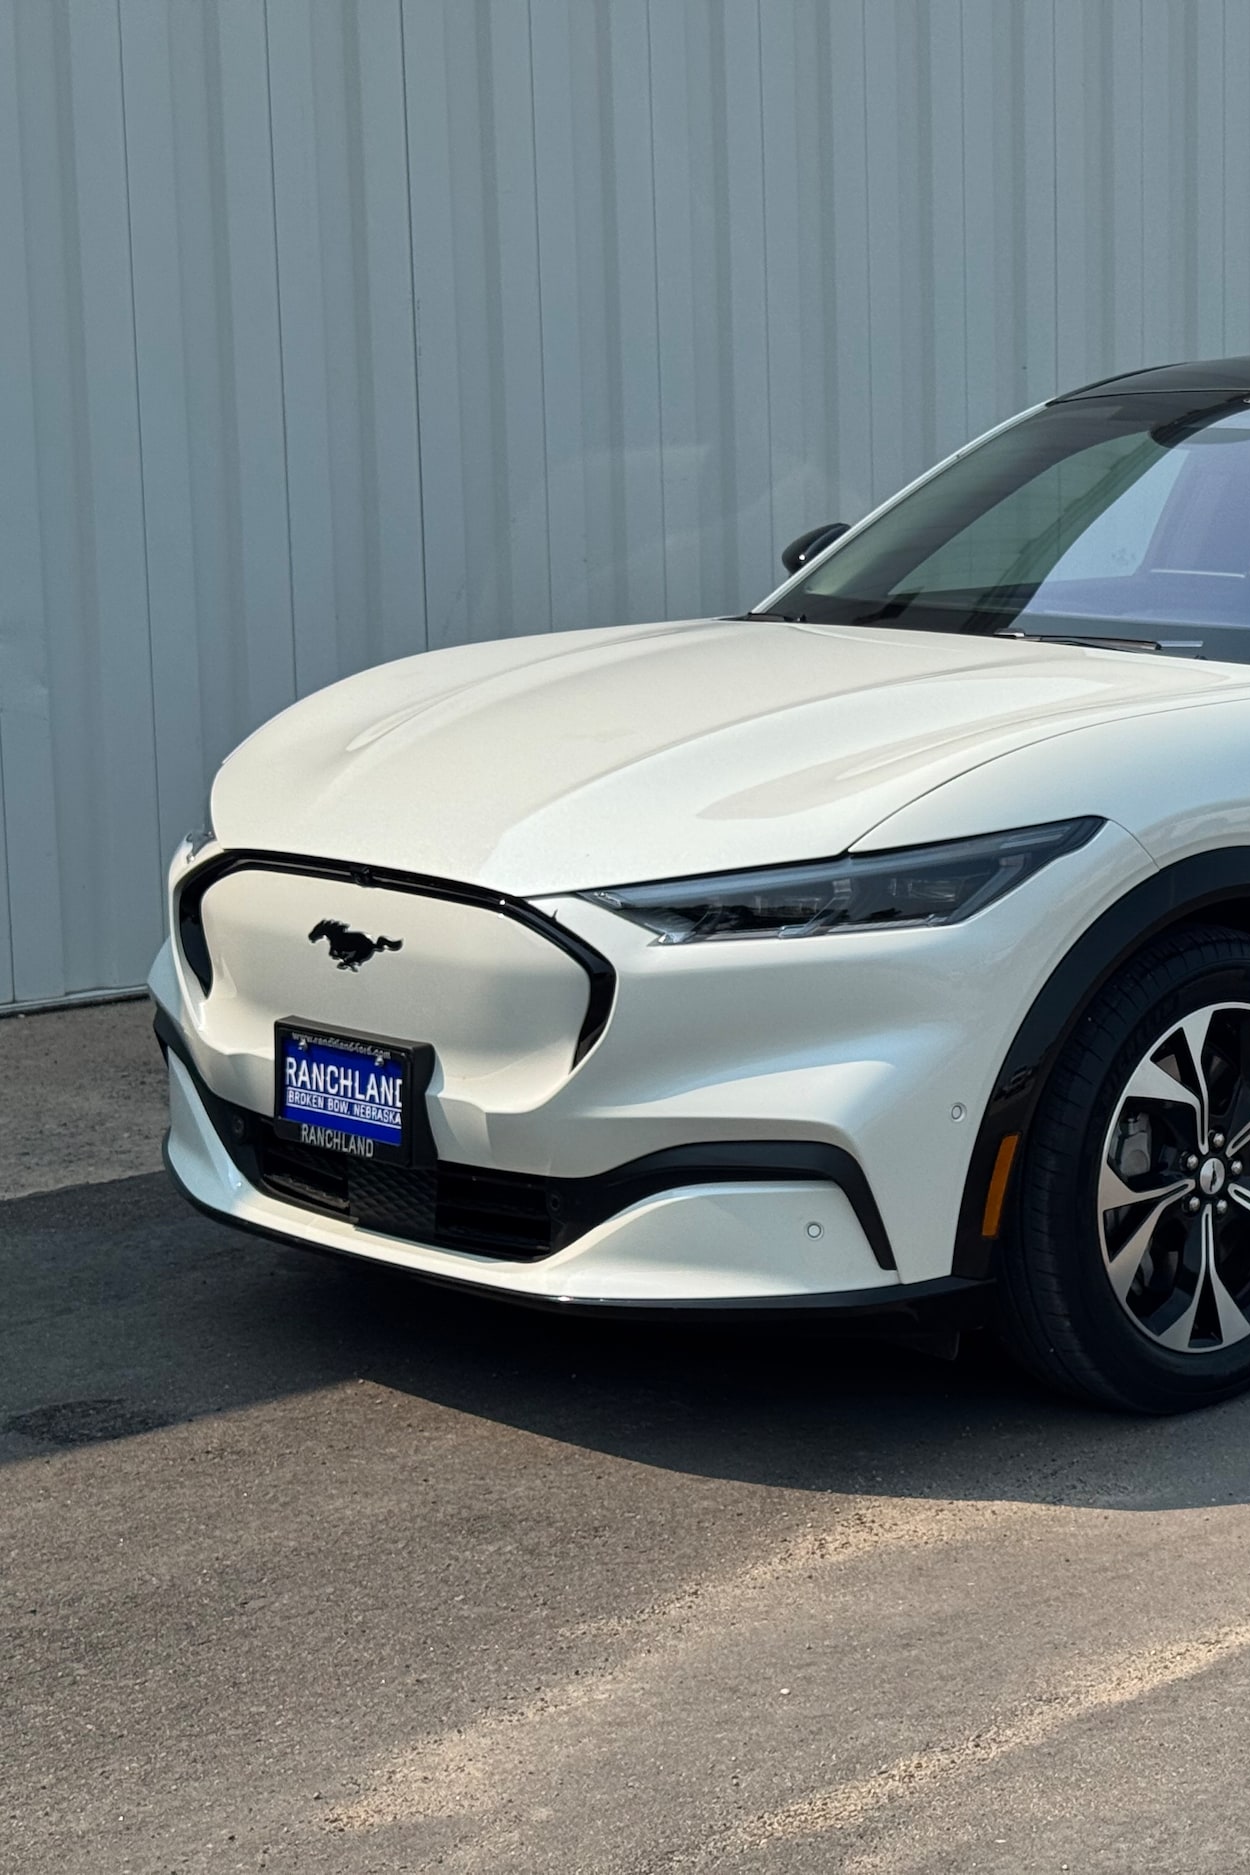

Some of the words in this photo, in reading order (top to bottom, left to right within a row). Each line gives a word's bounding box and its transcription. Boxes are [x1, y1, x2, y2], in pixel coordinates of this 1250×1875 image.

[288, 1090, 324, 1109] BROKEN
[354, 1104, 402, 1125] NEBRASKA
[302, 1124, 374, 1158] RANCHLAND
